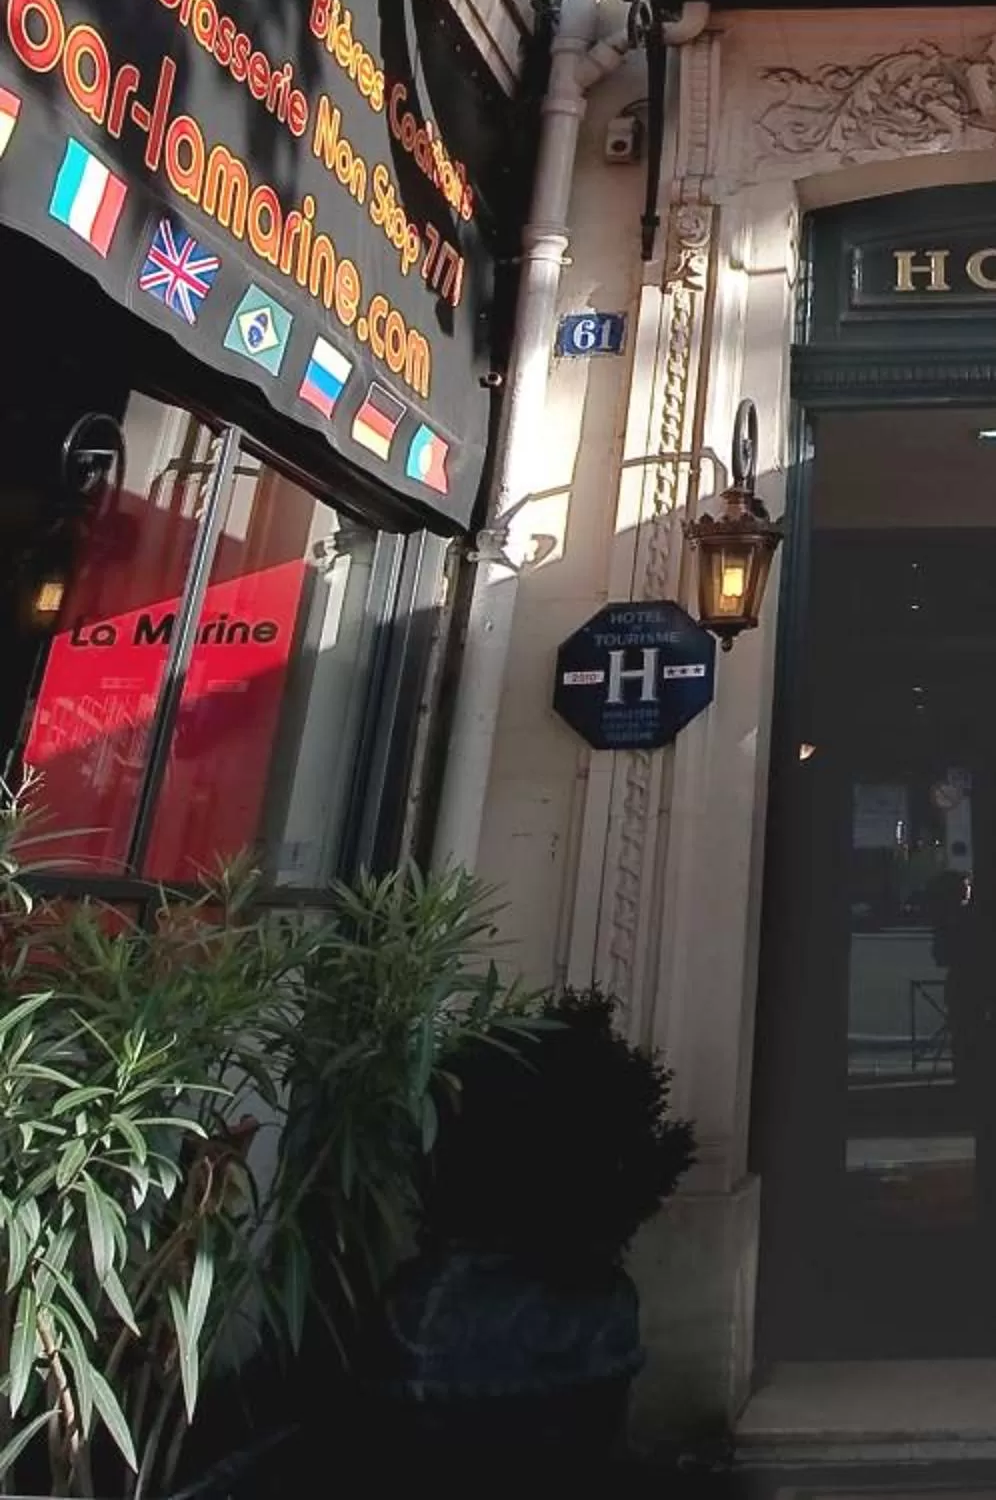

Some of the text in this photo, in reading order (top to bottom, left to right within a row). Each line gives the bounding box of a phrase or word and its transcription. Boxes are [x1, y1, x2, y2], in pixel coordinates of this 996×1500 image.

[313, 95, 367, 209] Non
[370, 163, 420, 277] Stop
[572, 318, 613, 350] 61
[69, 612, 279, 648] La Mrine
[605, 647, 661, 704] H
